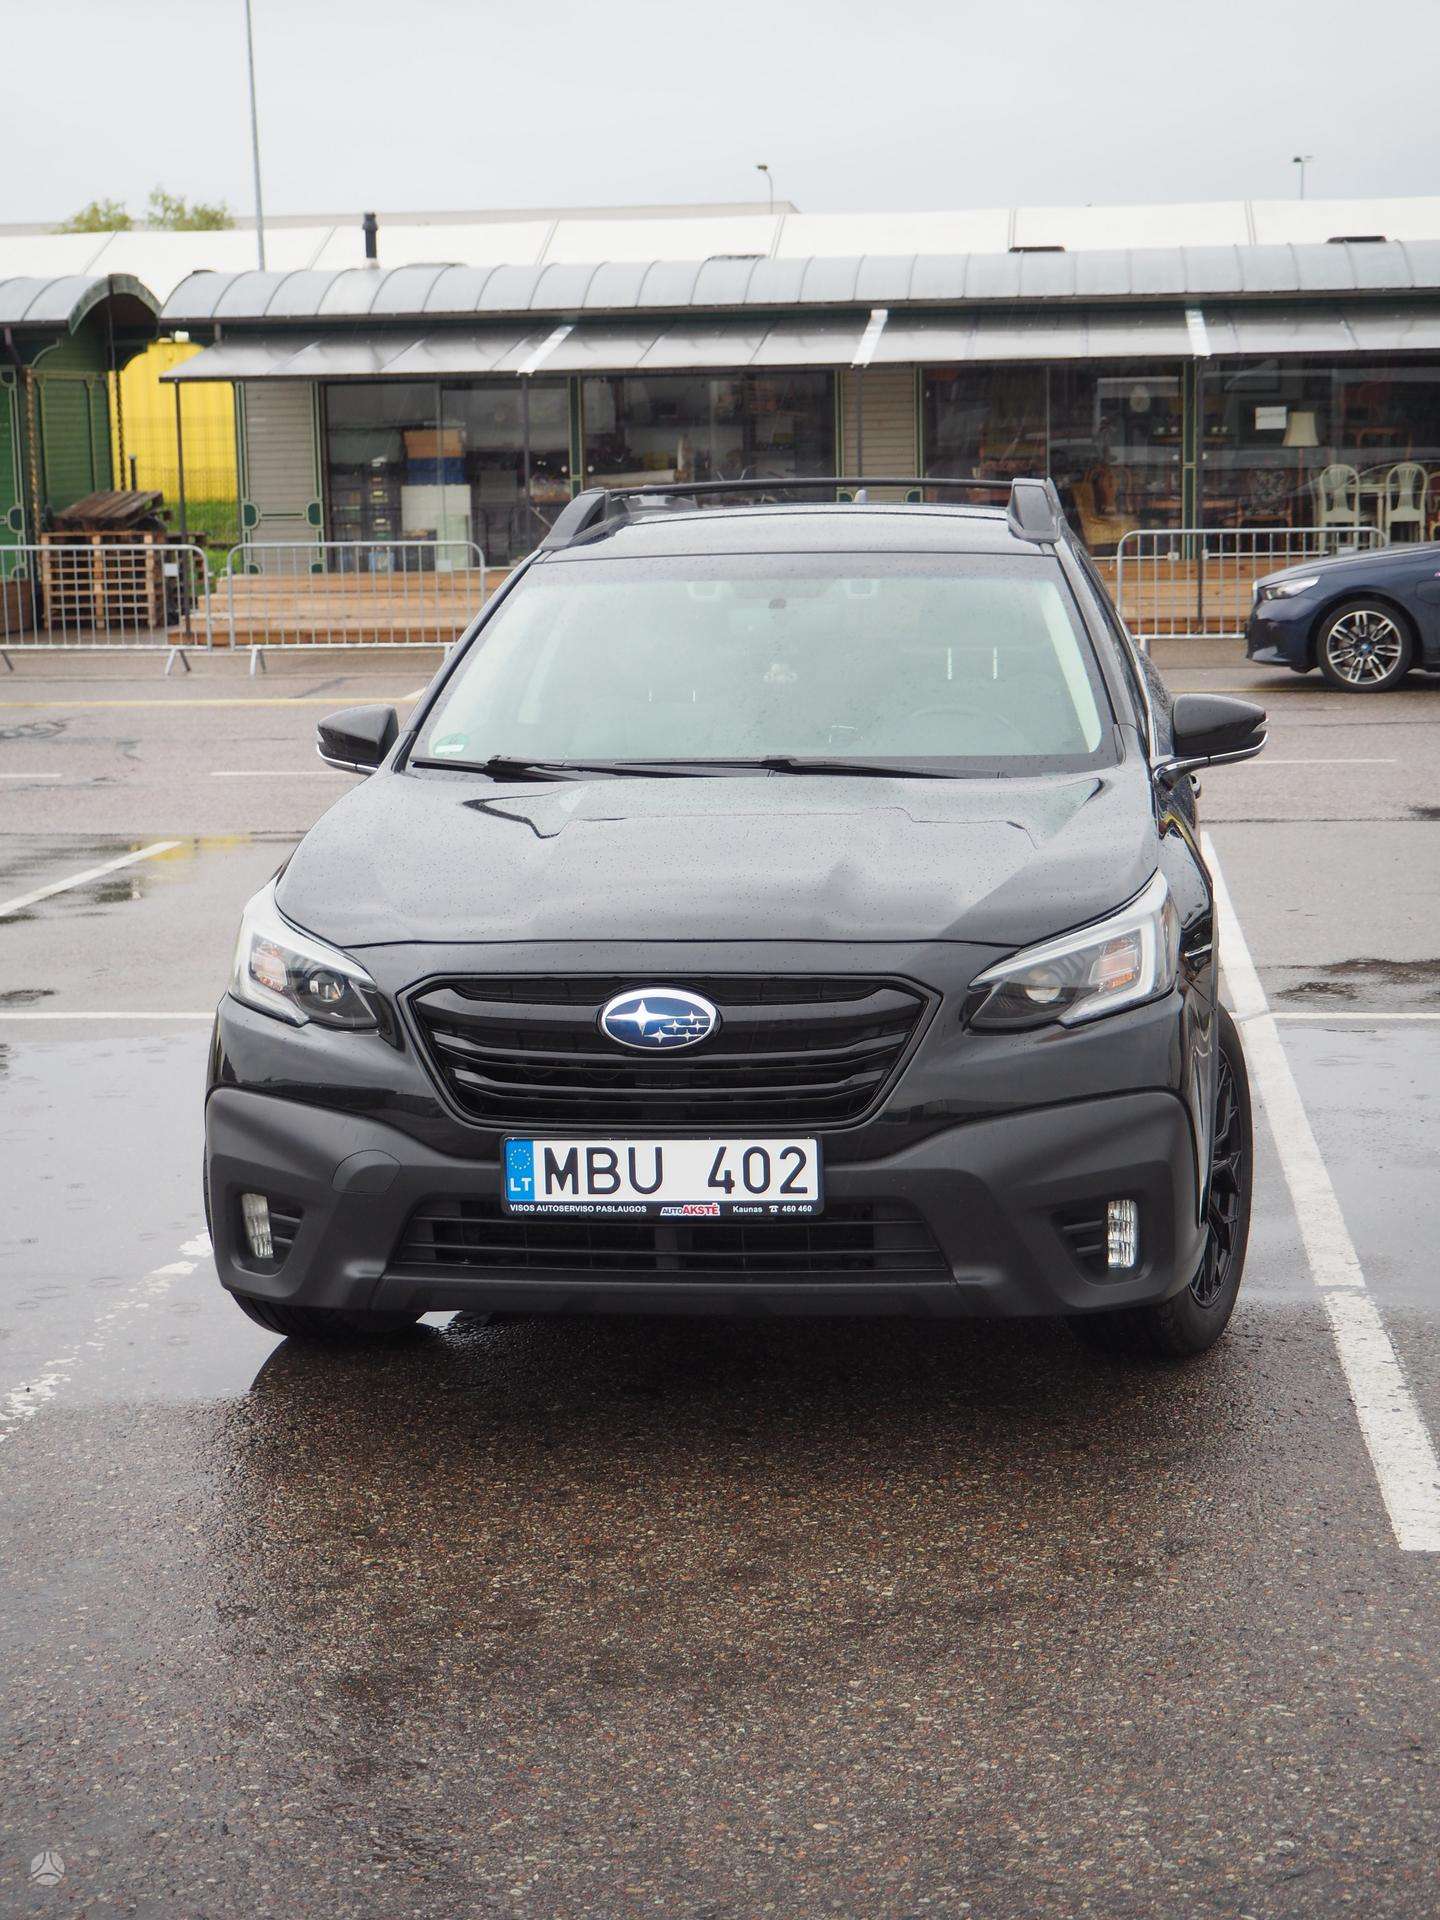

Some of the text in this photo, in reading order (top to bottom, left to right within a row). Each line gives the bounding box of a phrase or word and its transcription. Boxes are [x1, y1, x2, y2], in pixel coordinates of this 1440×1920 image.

[544, 1145, 808, 1195] MBU 402
[510, 1177, 532, 1193] LT
[510, 1204, 647, 1214] VISOS AUTOSERVISO PASLAUGOS
[733, 1205, 763, 1213] Kaunas
